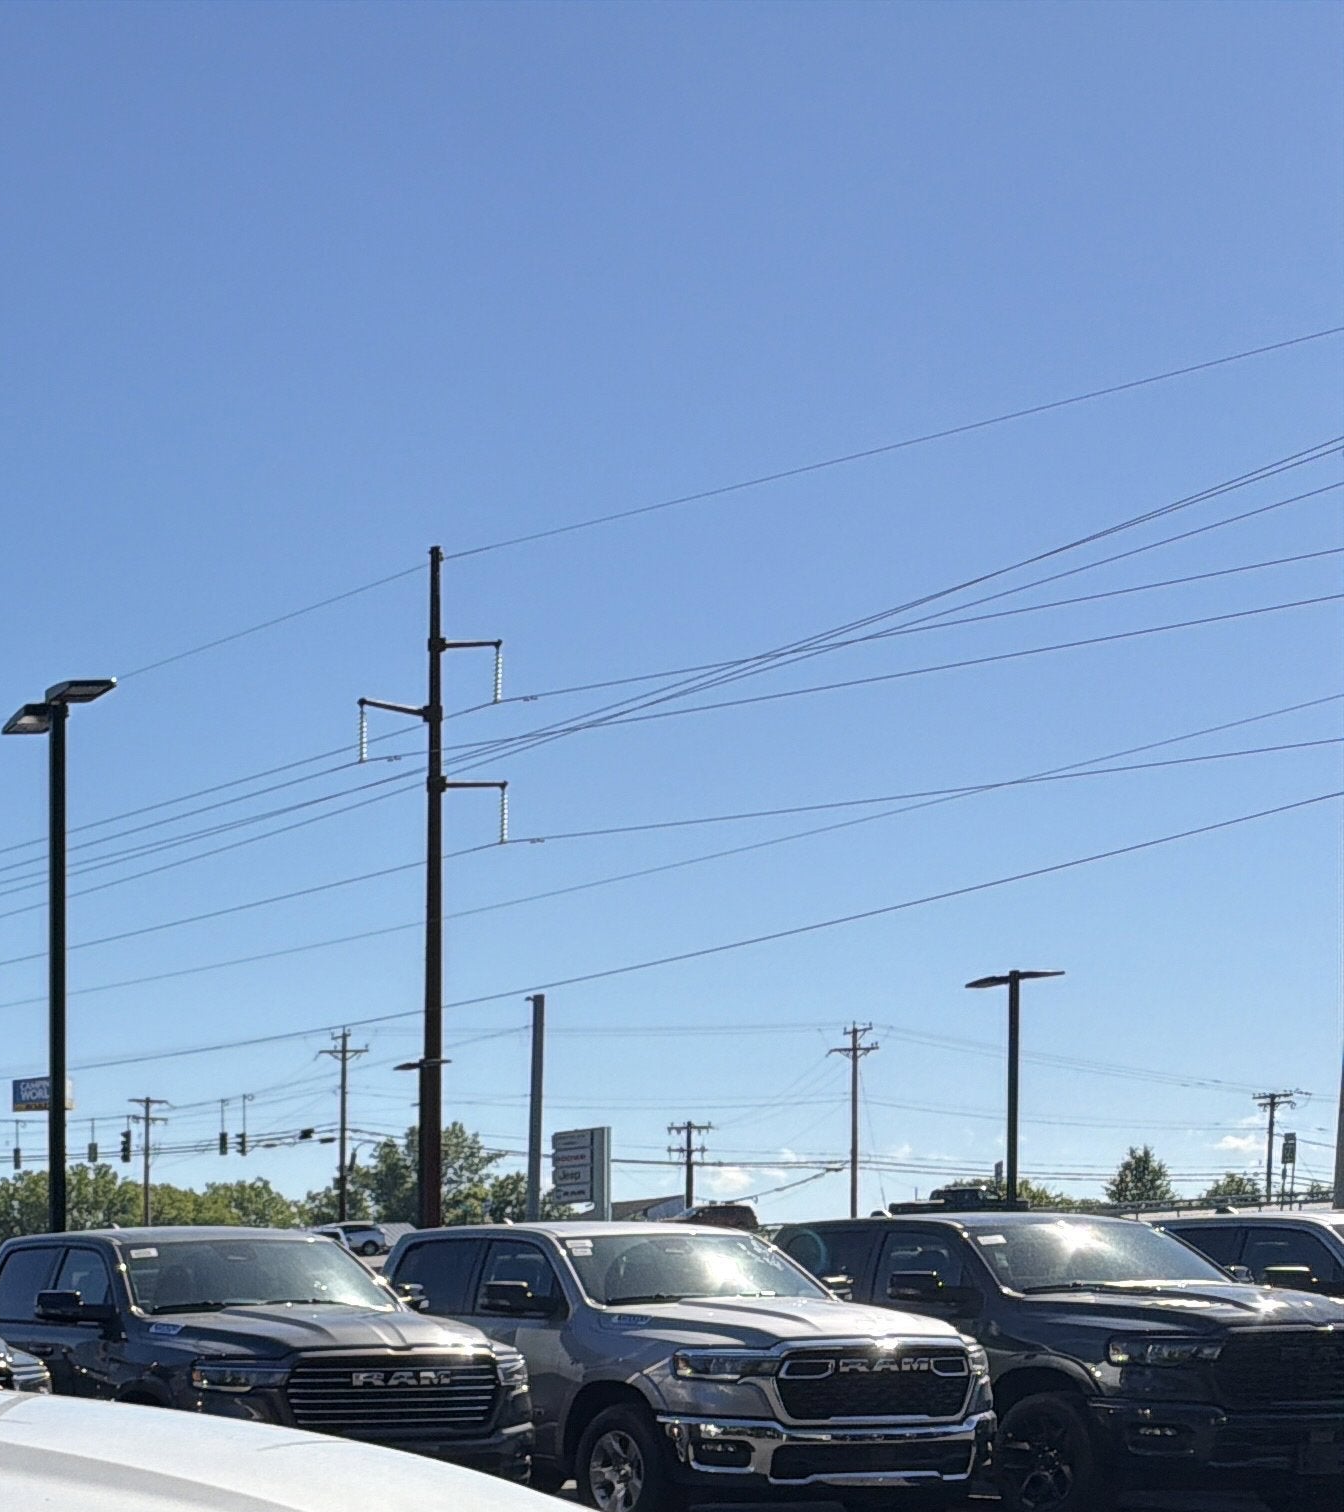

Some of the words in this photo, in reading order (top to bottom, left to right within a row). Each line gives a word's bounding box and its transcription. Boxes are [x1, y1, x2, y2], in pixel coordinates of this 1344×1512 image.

[21, 1087, 50, 1101] WORL
[559, 1169, 581, 1182] Jeep
[839, 1357, 930, 1373] RAM
[352, 1371, 451, 1387] RAM
